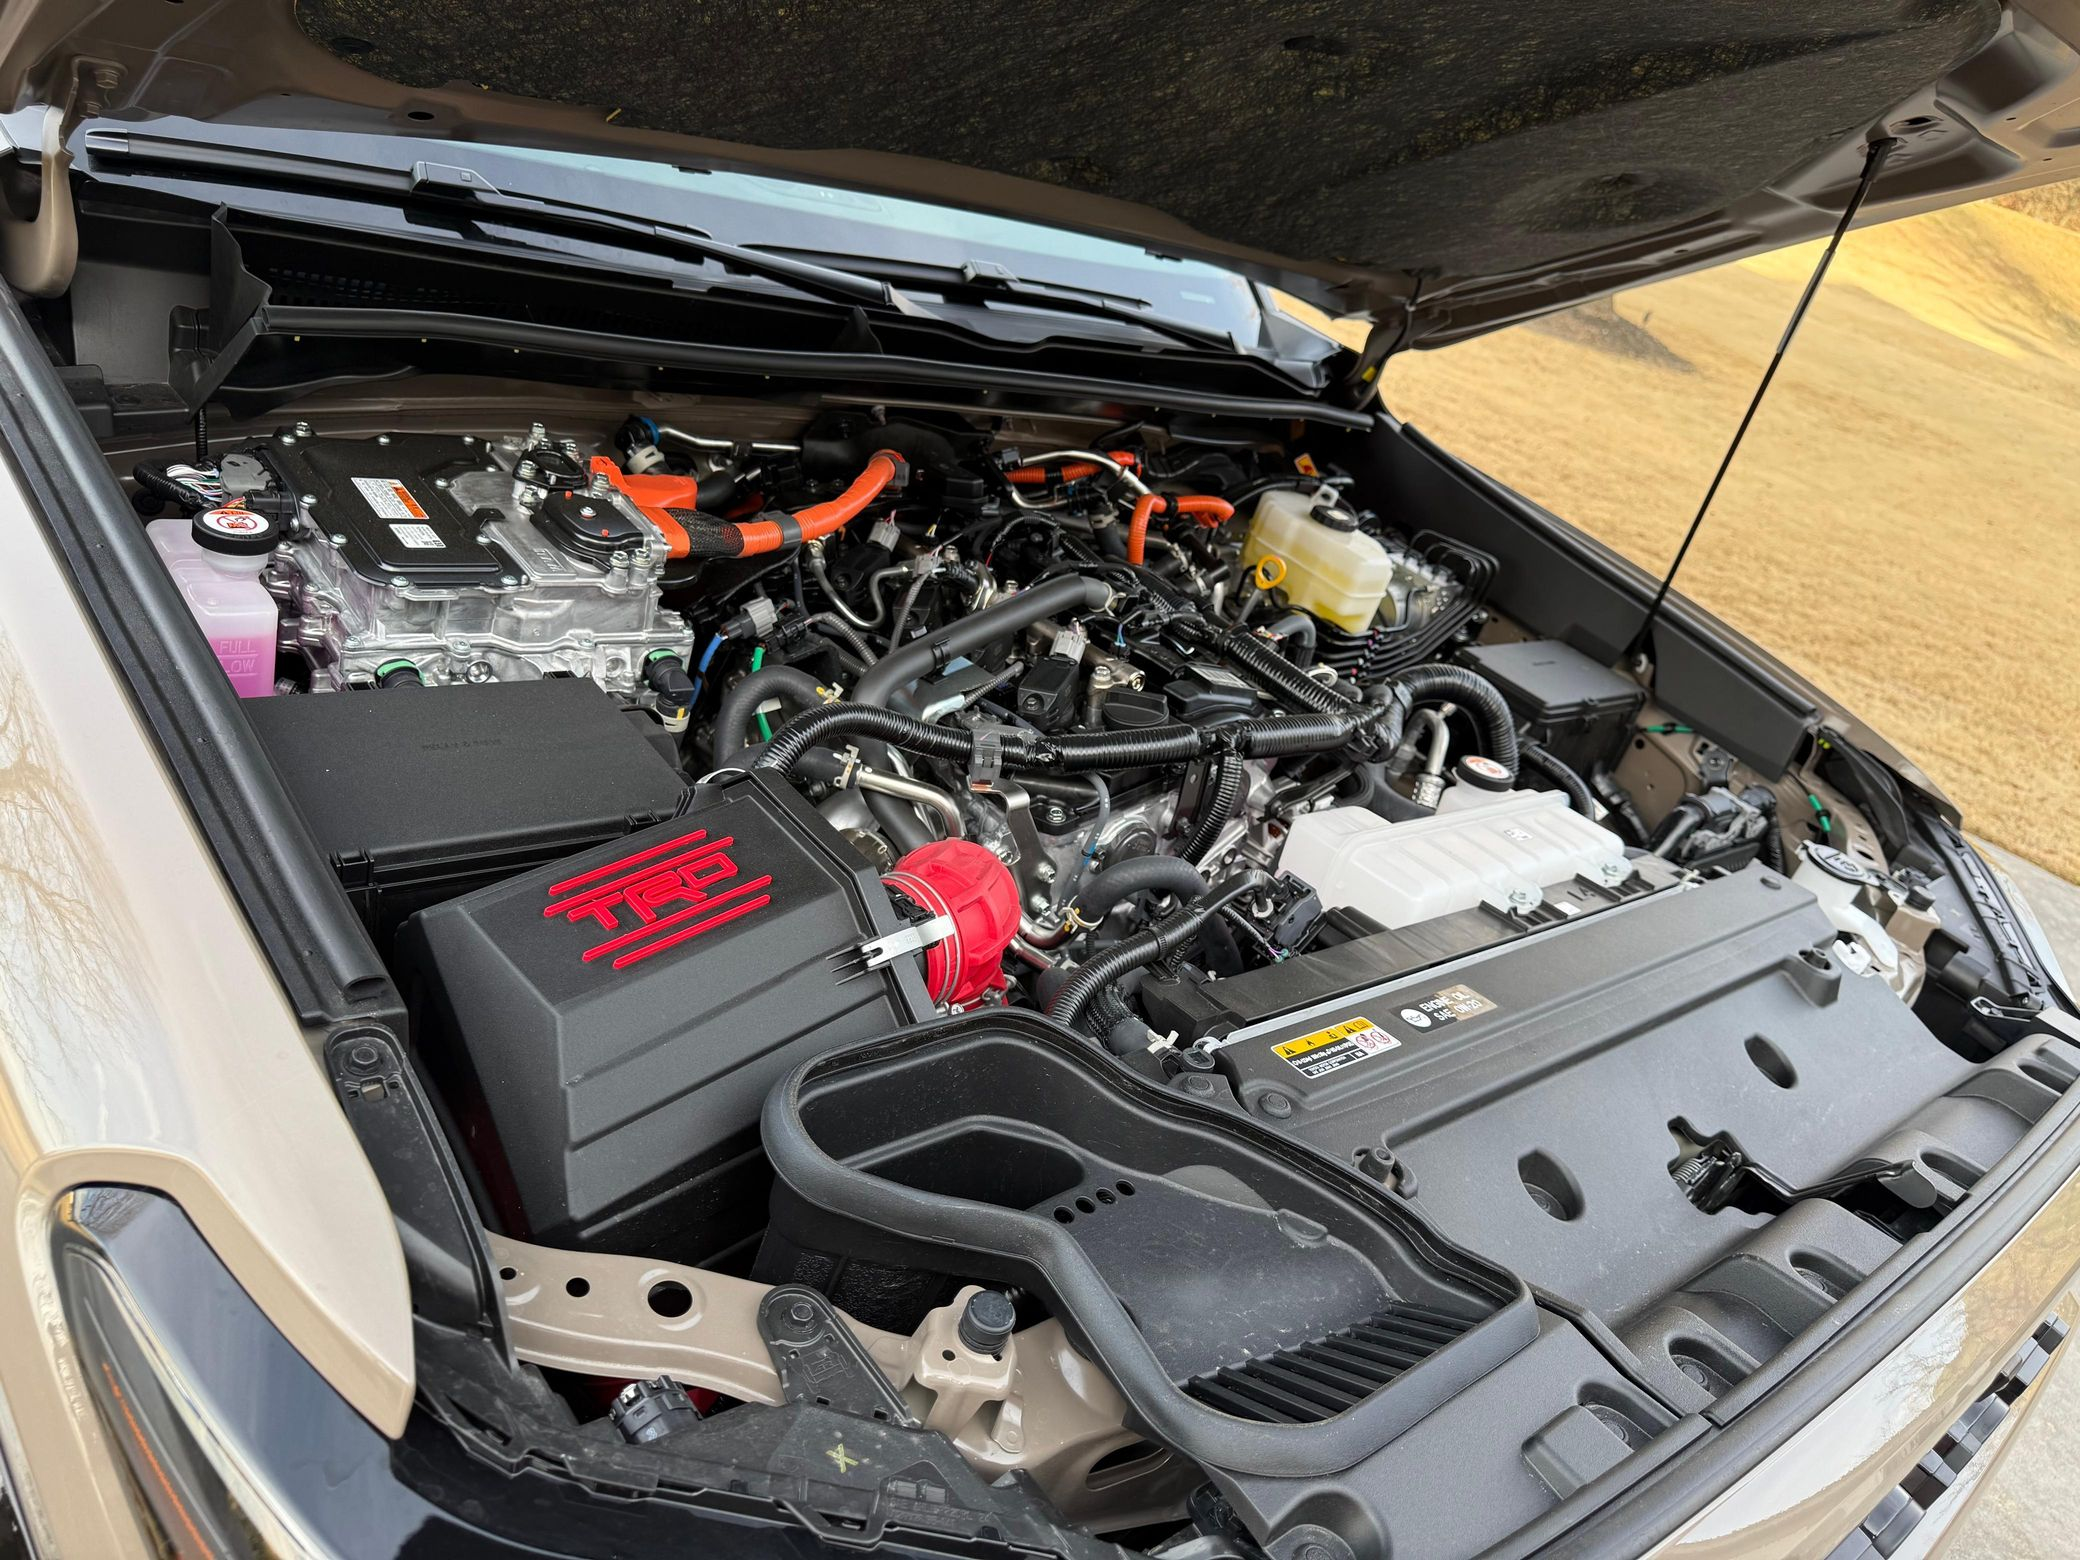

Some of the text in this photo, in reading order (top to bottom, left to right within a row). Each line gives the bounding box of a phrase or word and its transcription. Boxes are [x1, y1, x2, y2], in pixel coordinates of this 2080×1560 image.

[219, 640, 257, 654] FULL
[567, 851, 738, 931] TRD
[1419, 990, 1471, 1013] ENGINE OIL
[1434, 999, 1483, 1021] SAE 0W-20
